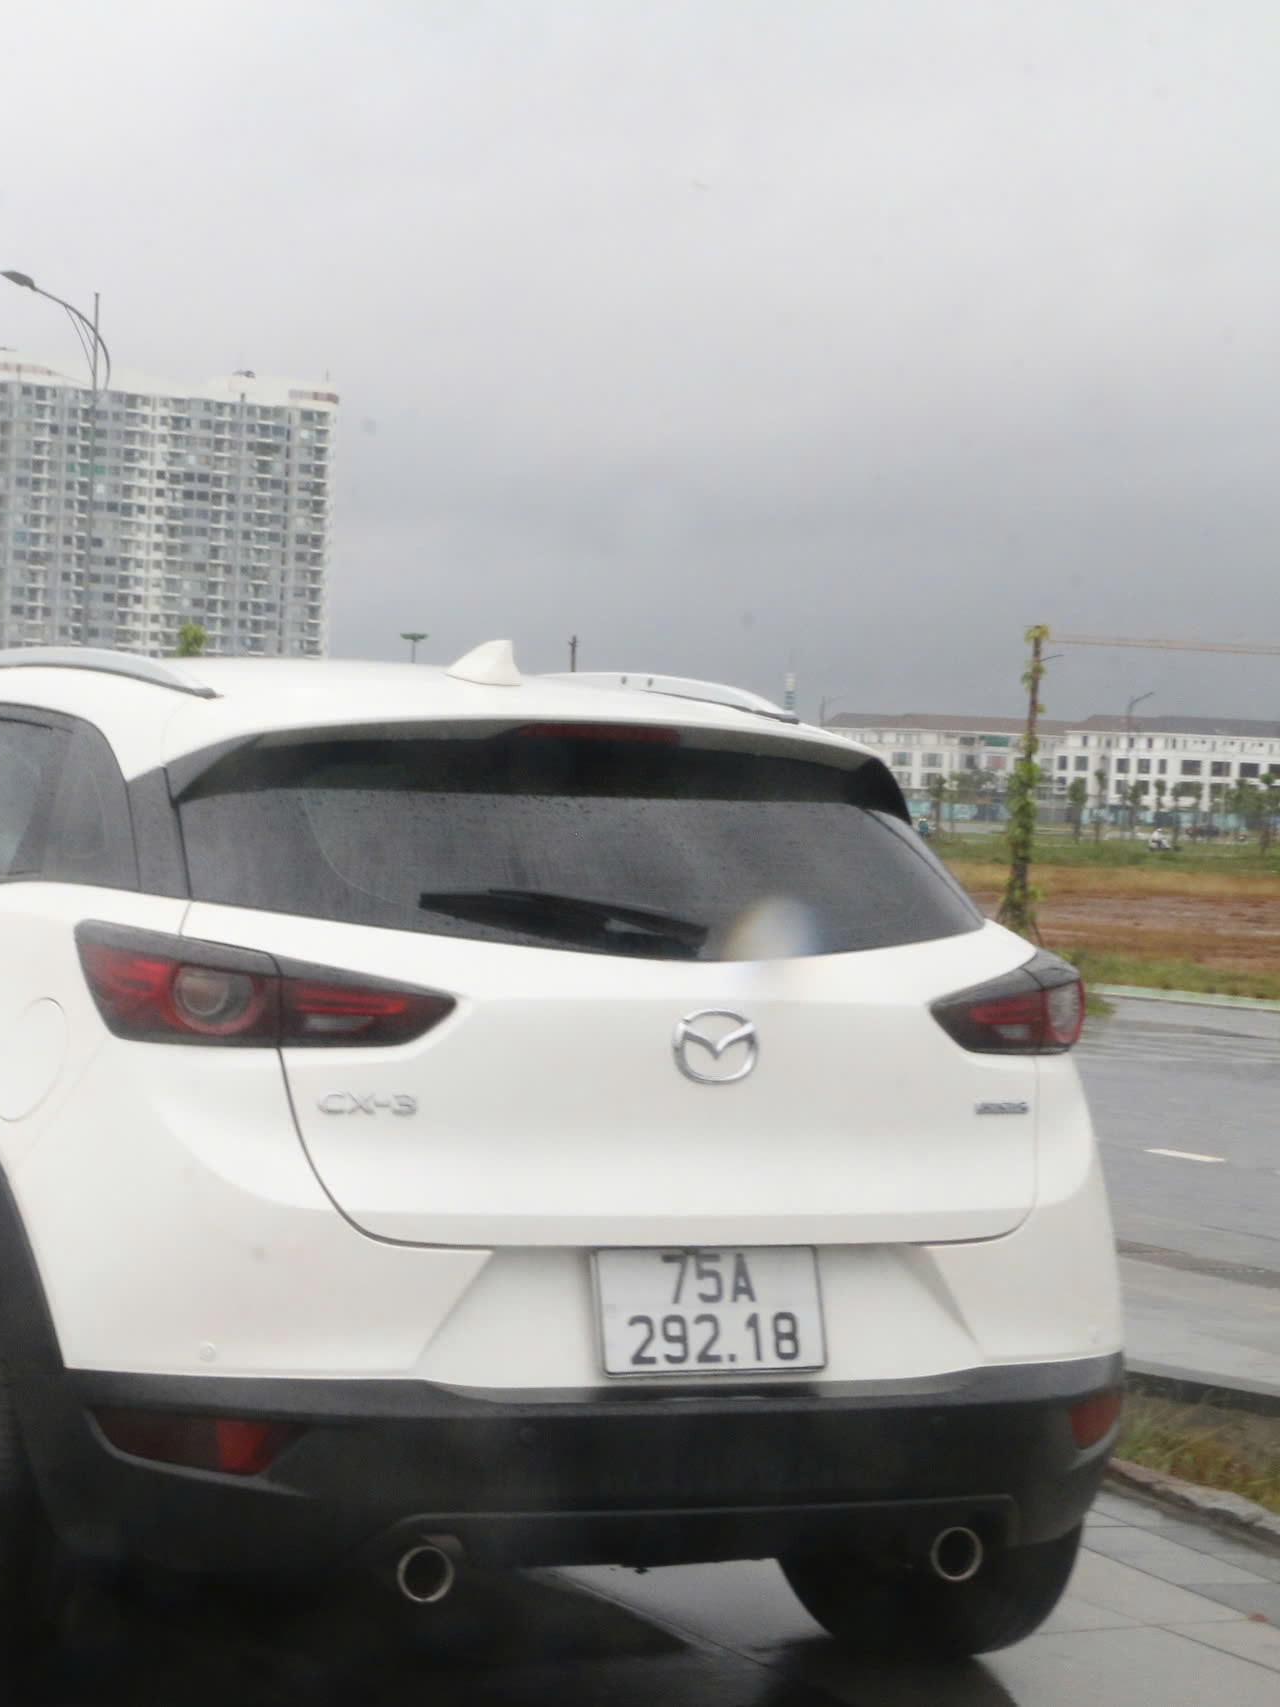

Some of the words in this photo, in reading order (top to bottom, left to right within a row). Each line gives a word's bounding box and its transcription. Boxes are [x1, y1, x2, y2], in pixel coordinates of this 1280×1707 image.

[317, 1091, 418, 1117] CX-3
[661, 1252, 757, 1304] 75A
[627, 1311, 800, 1365] 292.18
